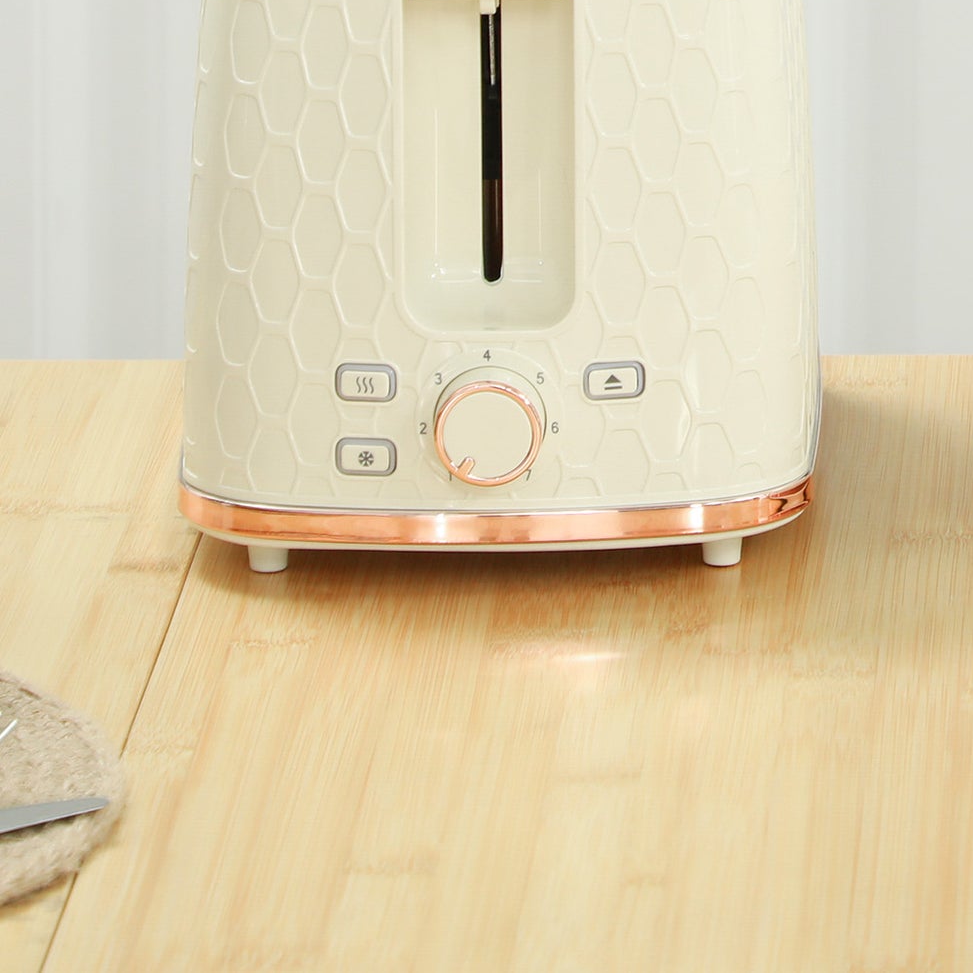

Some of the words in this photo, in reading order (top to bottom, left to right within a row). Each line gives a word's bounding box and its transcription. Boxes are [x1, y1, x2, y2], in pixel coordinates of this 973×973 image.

[482, 349, 491, 361] 4
[434, 373, 443, 385] 3
[536, 372, 545, 384] 5
[419, 422, 427, 435] 2
[551, 422, 559, 434] 6
